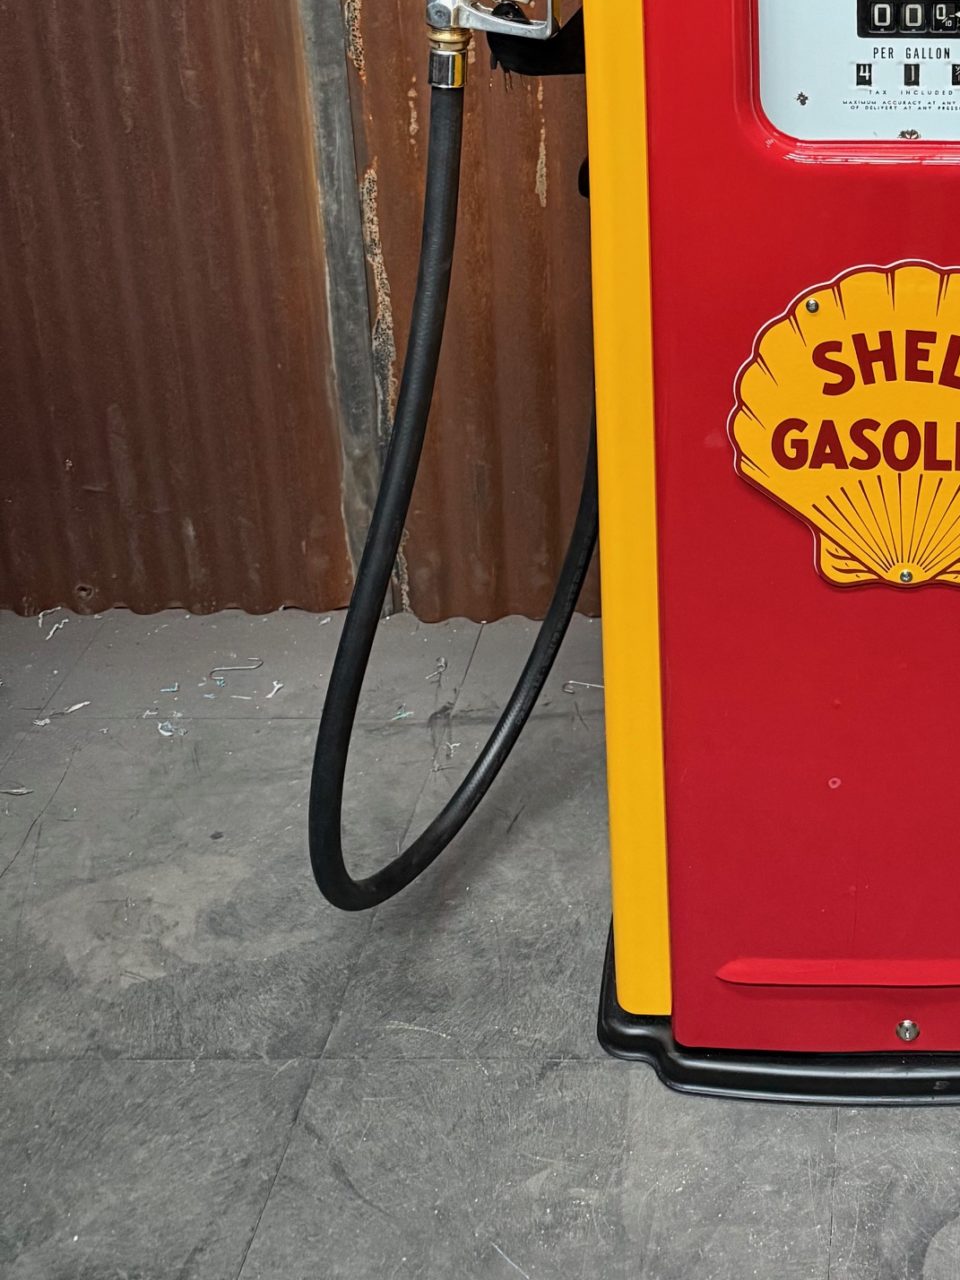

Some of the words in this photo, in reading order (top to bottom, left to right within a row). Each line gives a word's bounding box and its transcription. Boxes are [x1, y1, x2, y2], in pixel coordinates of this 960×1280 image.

[873, 47, 894, 60] PER
[905, 47, 951, 60] GALLON
[859, 64, 871, 81] 4
